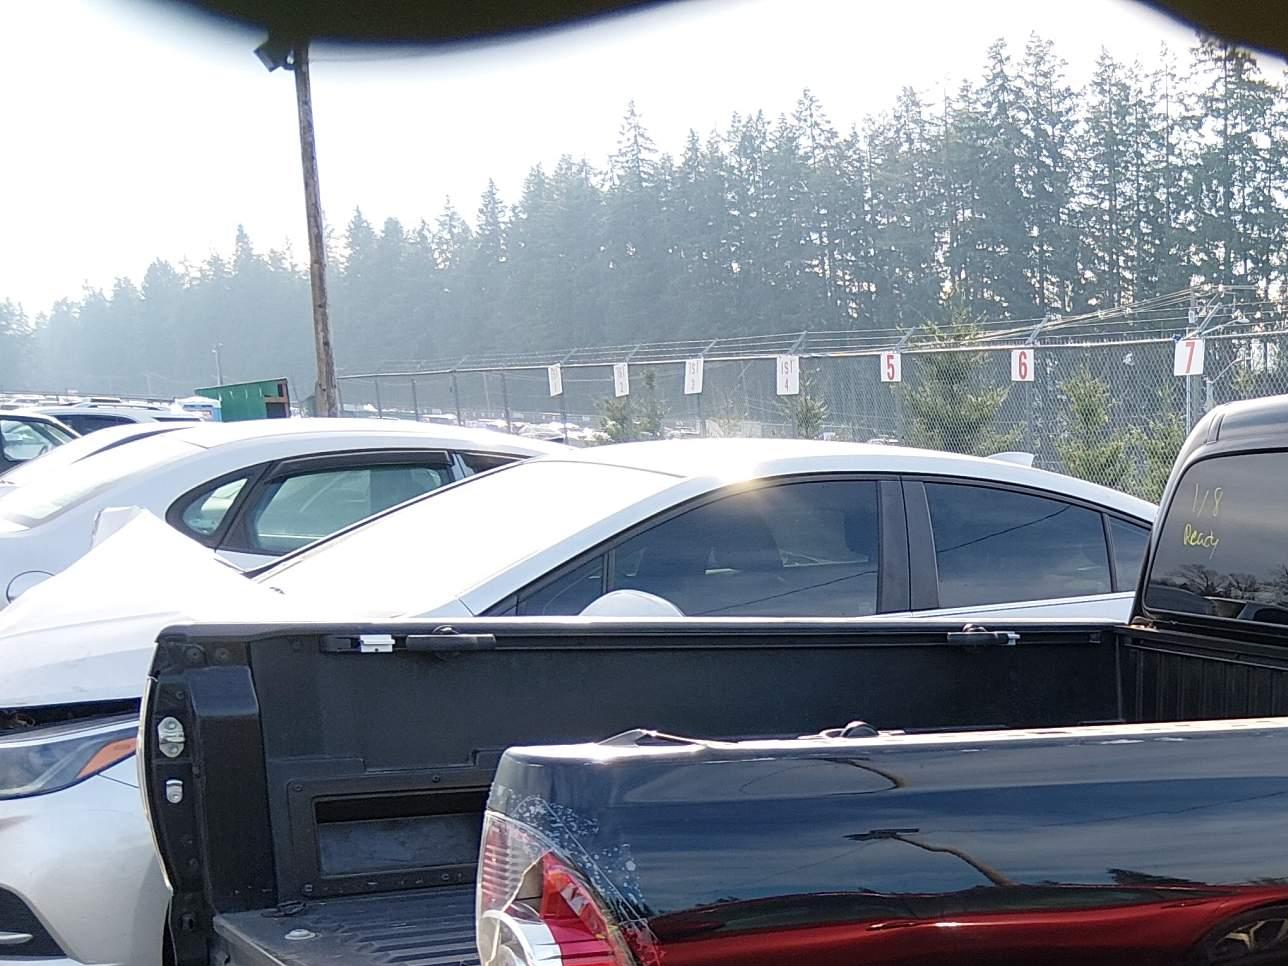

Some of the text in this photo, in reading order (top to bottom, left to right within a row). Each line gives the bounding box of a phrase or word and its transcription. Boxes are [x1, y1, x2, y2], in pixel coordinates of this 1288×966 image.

[886, 353, 896, 380] 5
[1018, 350, 1029, 380] 6
[1184, 340, 1197, 373] 7
